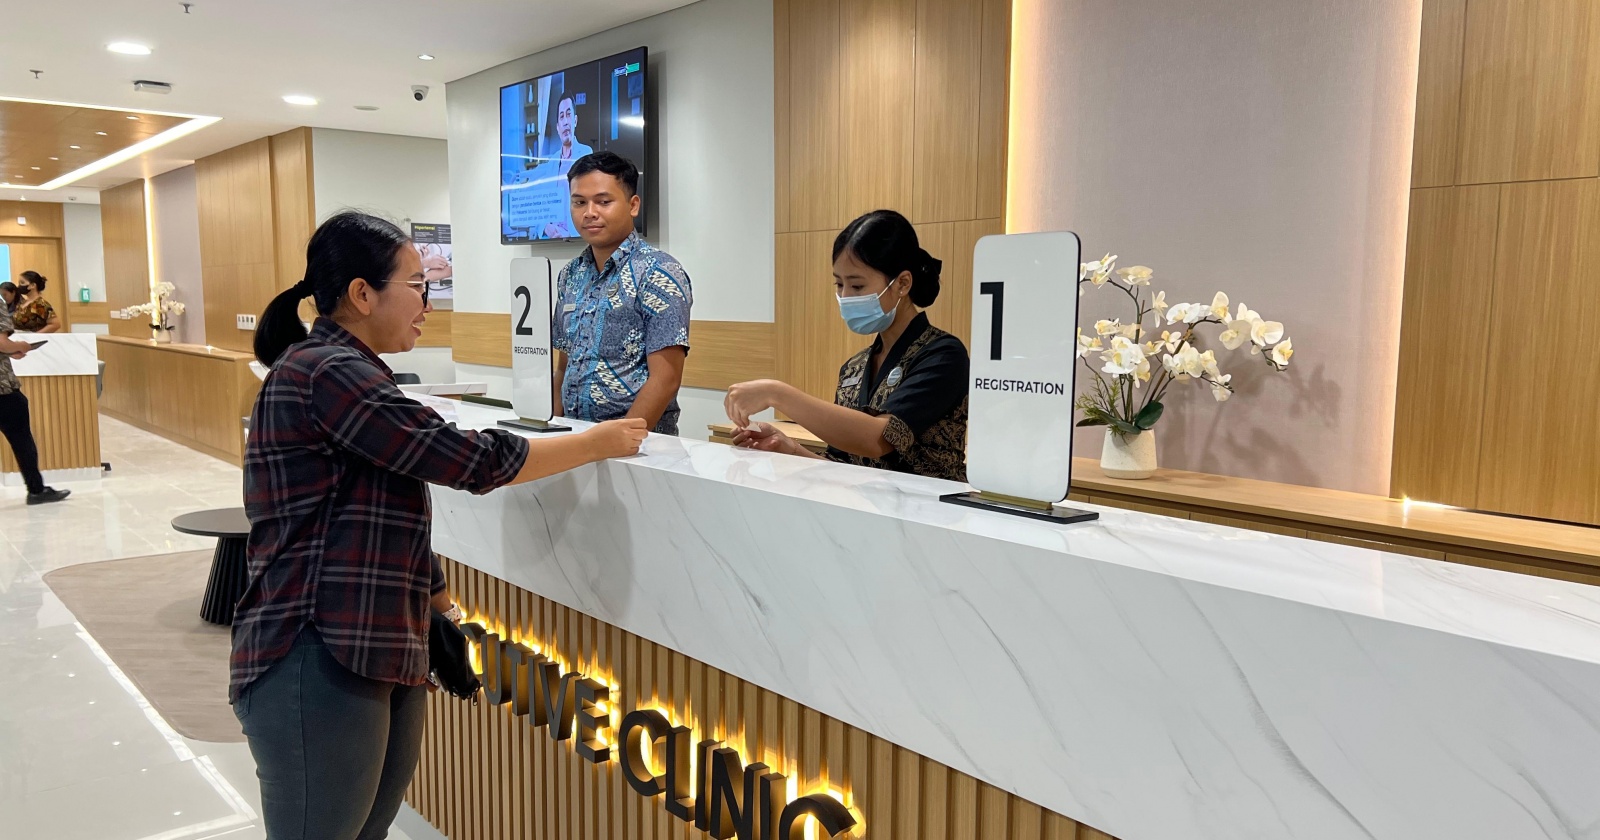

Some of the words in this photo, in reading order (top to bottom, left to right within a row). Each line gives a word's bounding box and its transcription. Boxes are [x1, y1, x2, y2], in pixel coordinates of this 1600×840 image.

[514, 285, 533, 336] 2
[980, 281, 1004, 361] 1
[514, 346, 549, 356] REGISTRATION
[975, 378, 1064, 396] REGISTRATION
[459, 622, 610, 764] UTIVE
